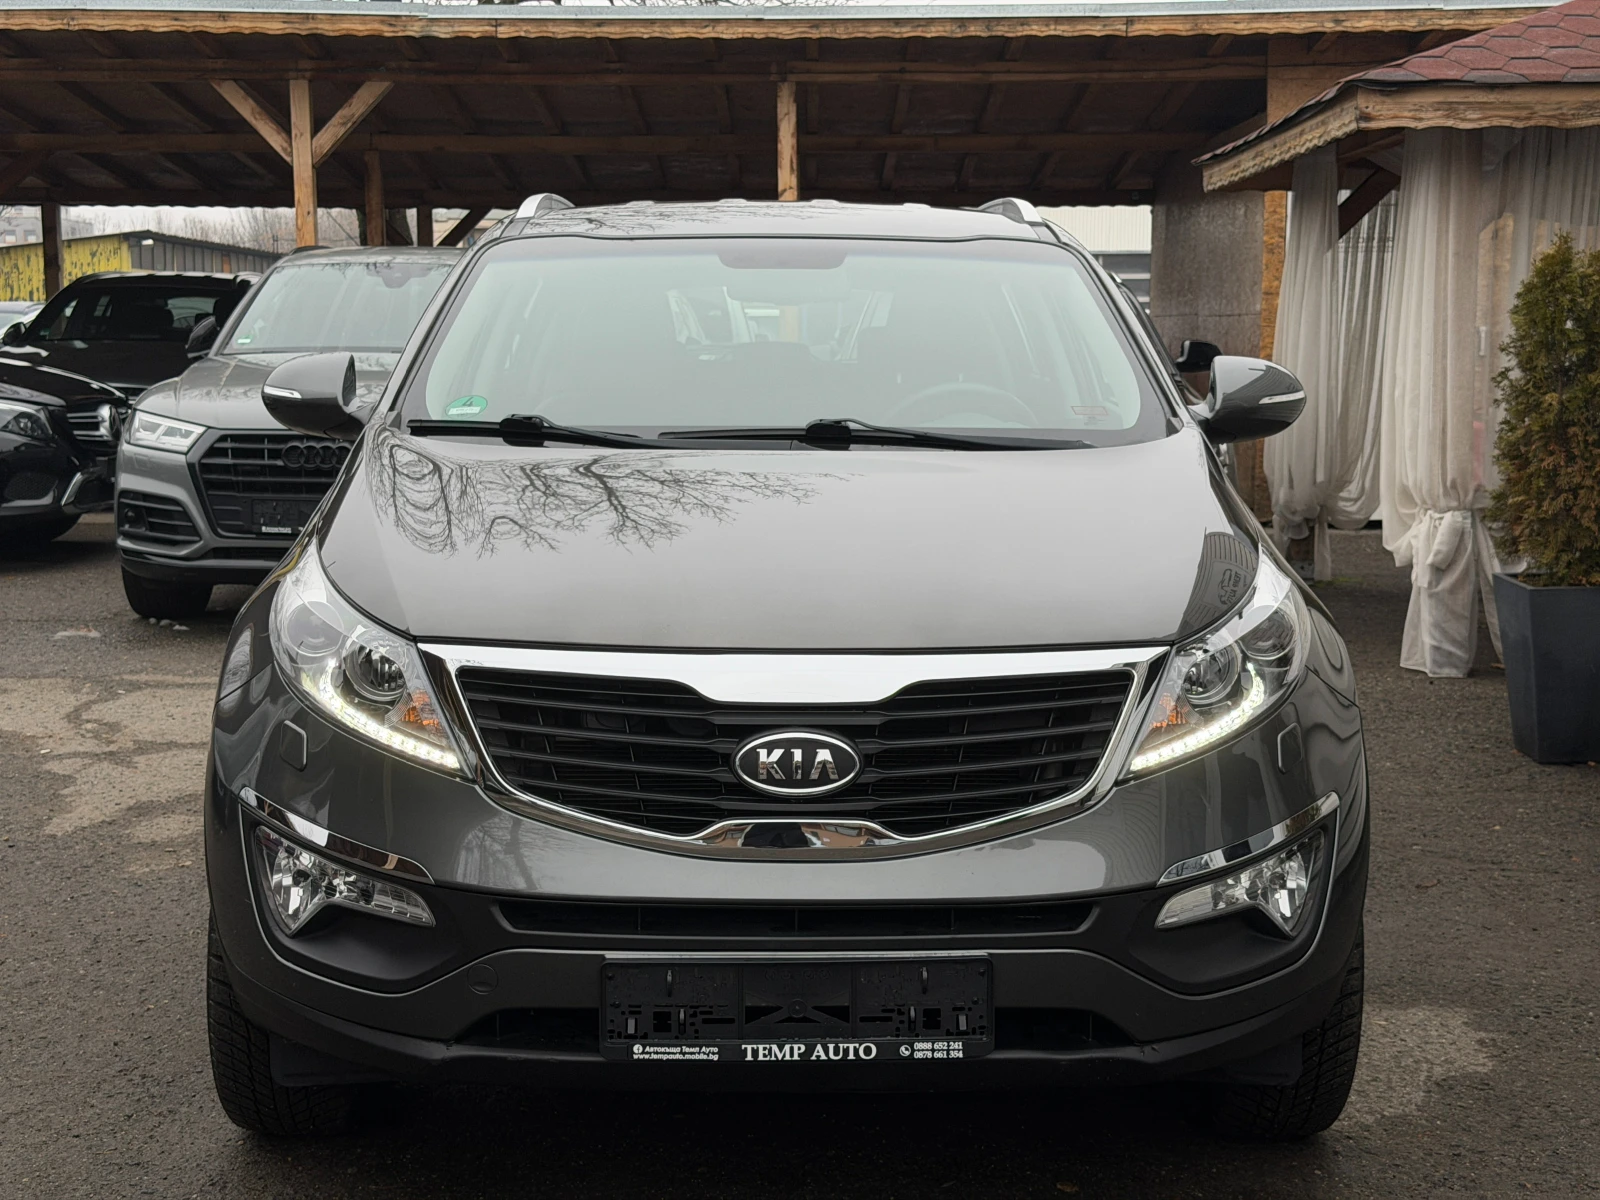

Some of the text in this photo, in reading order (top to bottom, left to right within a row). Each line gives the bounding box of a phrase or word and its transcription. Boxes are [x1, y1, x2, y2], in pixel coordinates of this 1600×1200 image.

[756, 748, 839, 780] KIA
[700, 1046, 719, 1054] Ауто
[913, 1041, 963, 1050] 0888 652 241
[741, 1043, 877, 1061] TEMP AUTO
[913, 1050, 964, 1059] 0878 661 354
[632, 1053, 719, 1061] www.tempauto.mobile.bg
